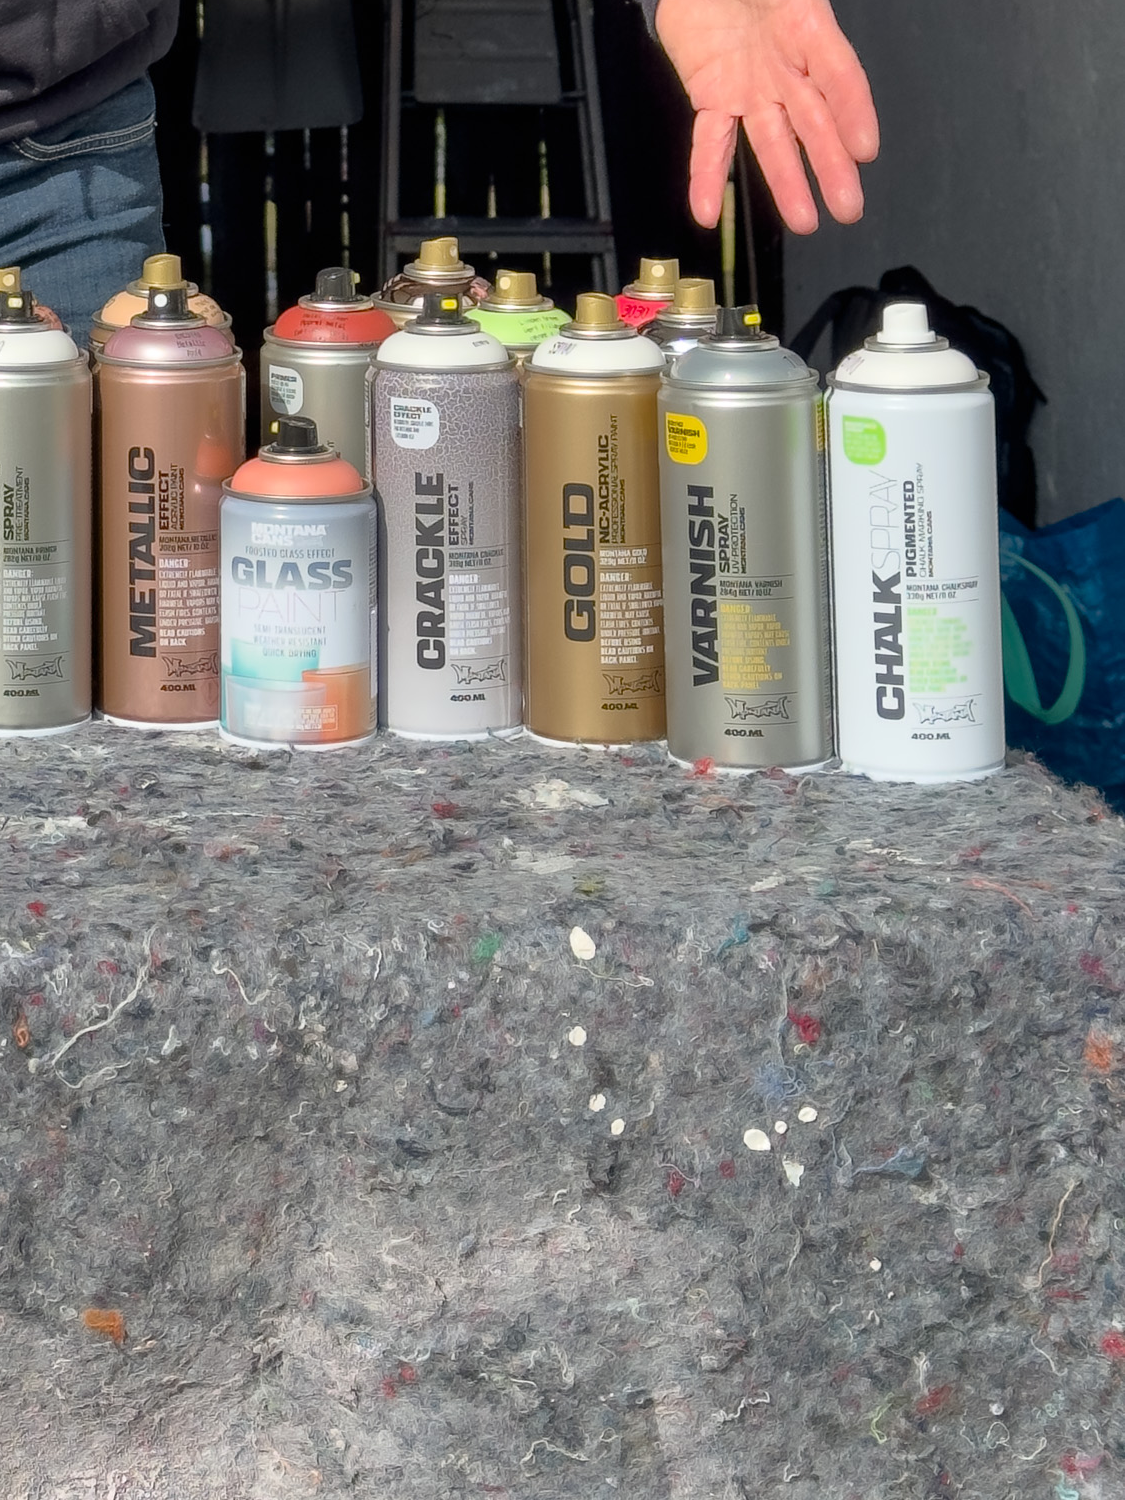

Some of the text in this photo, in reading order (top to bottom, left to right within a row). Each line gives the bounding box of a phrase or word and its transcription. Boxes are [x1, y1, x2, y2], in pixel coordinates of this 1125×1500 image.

[609, 414, 618, 441] PAINT
[4, 484, 16, 541] SPRAY
[16, 466, 24, 542] PRE-TREATMENT
[159, 470, 170, 531] EFFECT
[599, 435, 610, 544] NC-ACRYLIC
[610, 477, 619, 544] PROFESSIONAL
[250, 521, 328, 537] MONTANA
[448, 484, 460, 546] EFFECT
[460, 515, 468, 546] SPRAY
[730, 494, 738, 574] UV-PROTECTION
[903, 480, 917, 578] PIGMENTED
[916, 462, 926, 578] CHALK MARKING SPRAY
[3, 546, 34, 555] MONTANA
[128, 446, 157, 658] METALLIC
[159, 535, 190, 544] MONTANA
[244, 546, 335, 560] FROSTED GLASS EFFECT
[250, 533, 294, 547] CANS
[449, 550, 479, 560] MONTANA
[563, 482, 596, 642] GOLD
[599, 549, 631, 558] MONTANA
[718, 513, 730, 574] SPRAY
[926, 510, 934, 577] MONTANA CANS
[231, 554, 354, 591] GLASS
[414, 472, 446, 670] CRACKLE
[687, 484, 720, 687] VARNISH
[720, 580, 753, 588] MONTANA
[906, 583, 939, 592] MONTANA
[237, 588, 347, 624] PAINT
[262, 646, 318, 659] QUICK DRYING
[288, 636, 327, 647] RESISTANT
